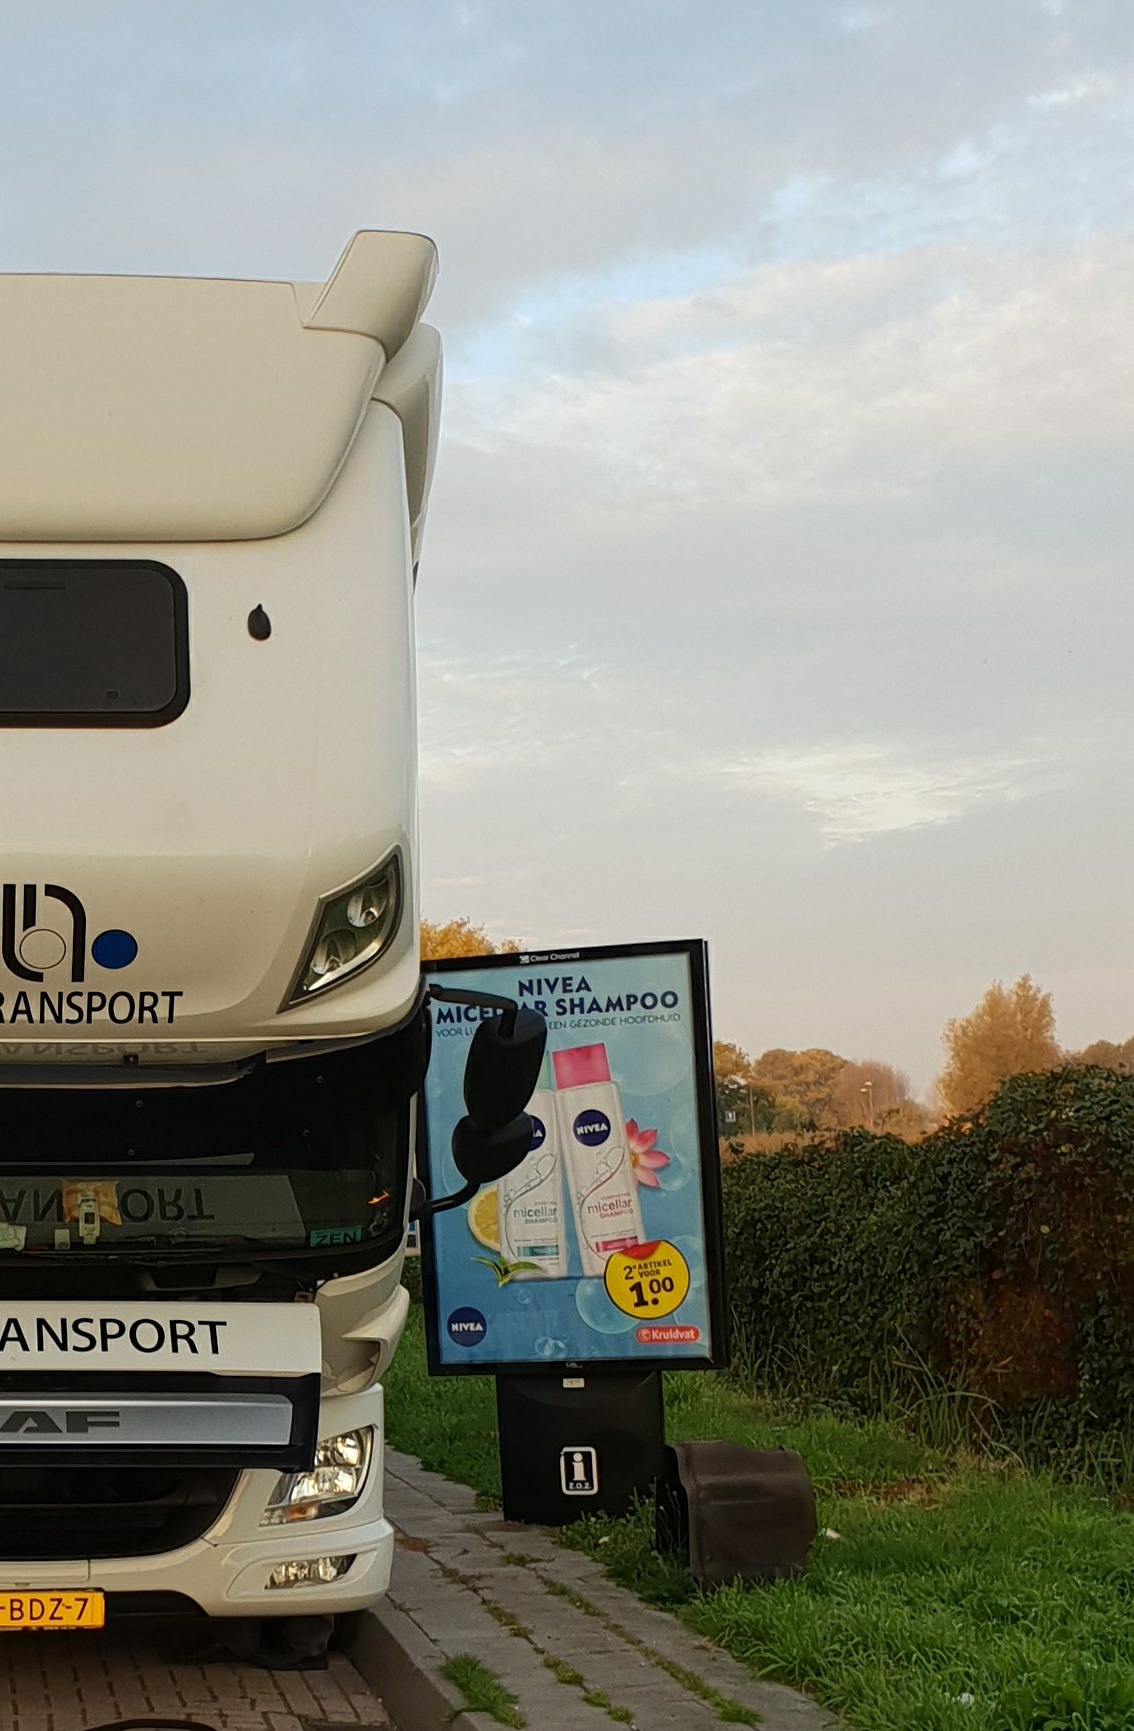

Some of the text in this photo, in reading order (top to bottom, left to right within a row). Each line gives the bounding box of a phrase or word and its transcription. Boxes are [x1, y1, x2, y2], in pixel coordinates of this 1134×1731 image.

[517, 976, 592, 997] NIVEA
[555, 990, 679, 1016] SHAMPOO
[436, 1027, 463, 1038] VOOR
[548, 1017, 567, 1030] EEN
[569, 1016, 617, 1029] GEZONDE
[619, 1013, 681, 1026] HOOFDHUID
[576, 1122, 608, 1135] NIVEA
[513, 1207, 557, 1218] micellar
[587, 1199, 632, 1215] micellar
[315, 1231, 357, 1246] ZEN
[637, 1259, 673, 1271] ARTIKEL
[638, 1268, 661, 1279] VOOR
[451, 1322, 484, 1332] NIVEA
[651, 1328, 695, 1340] Kruidvat
